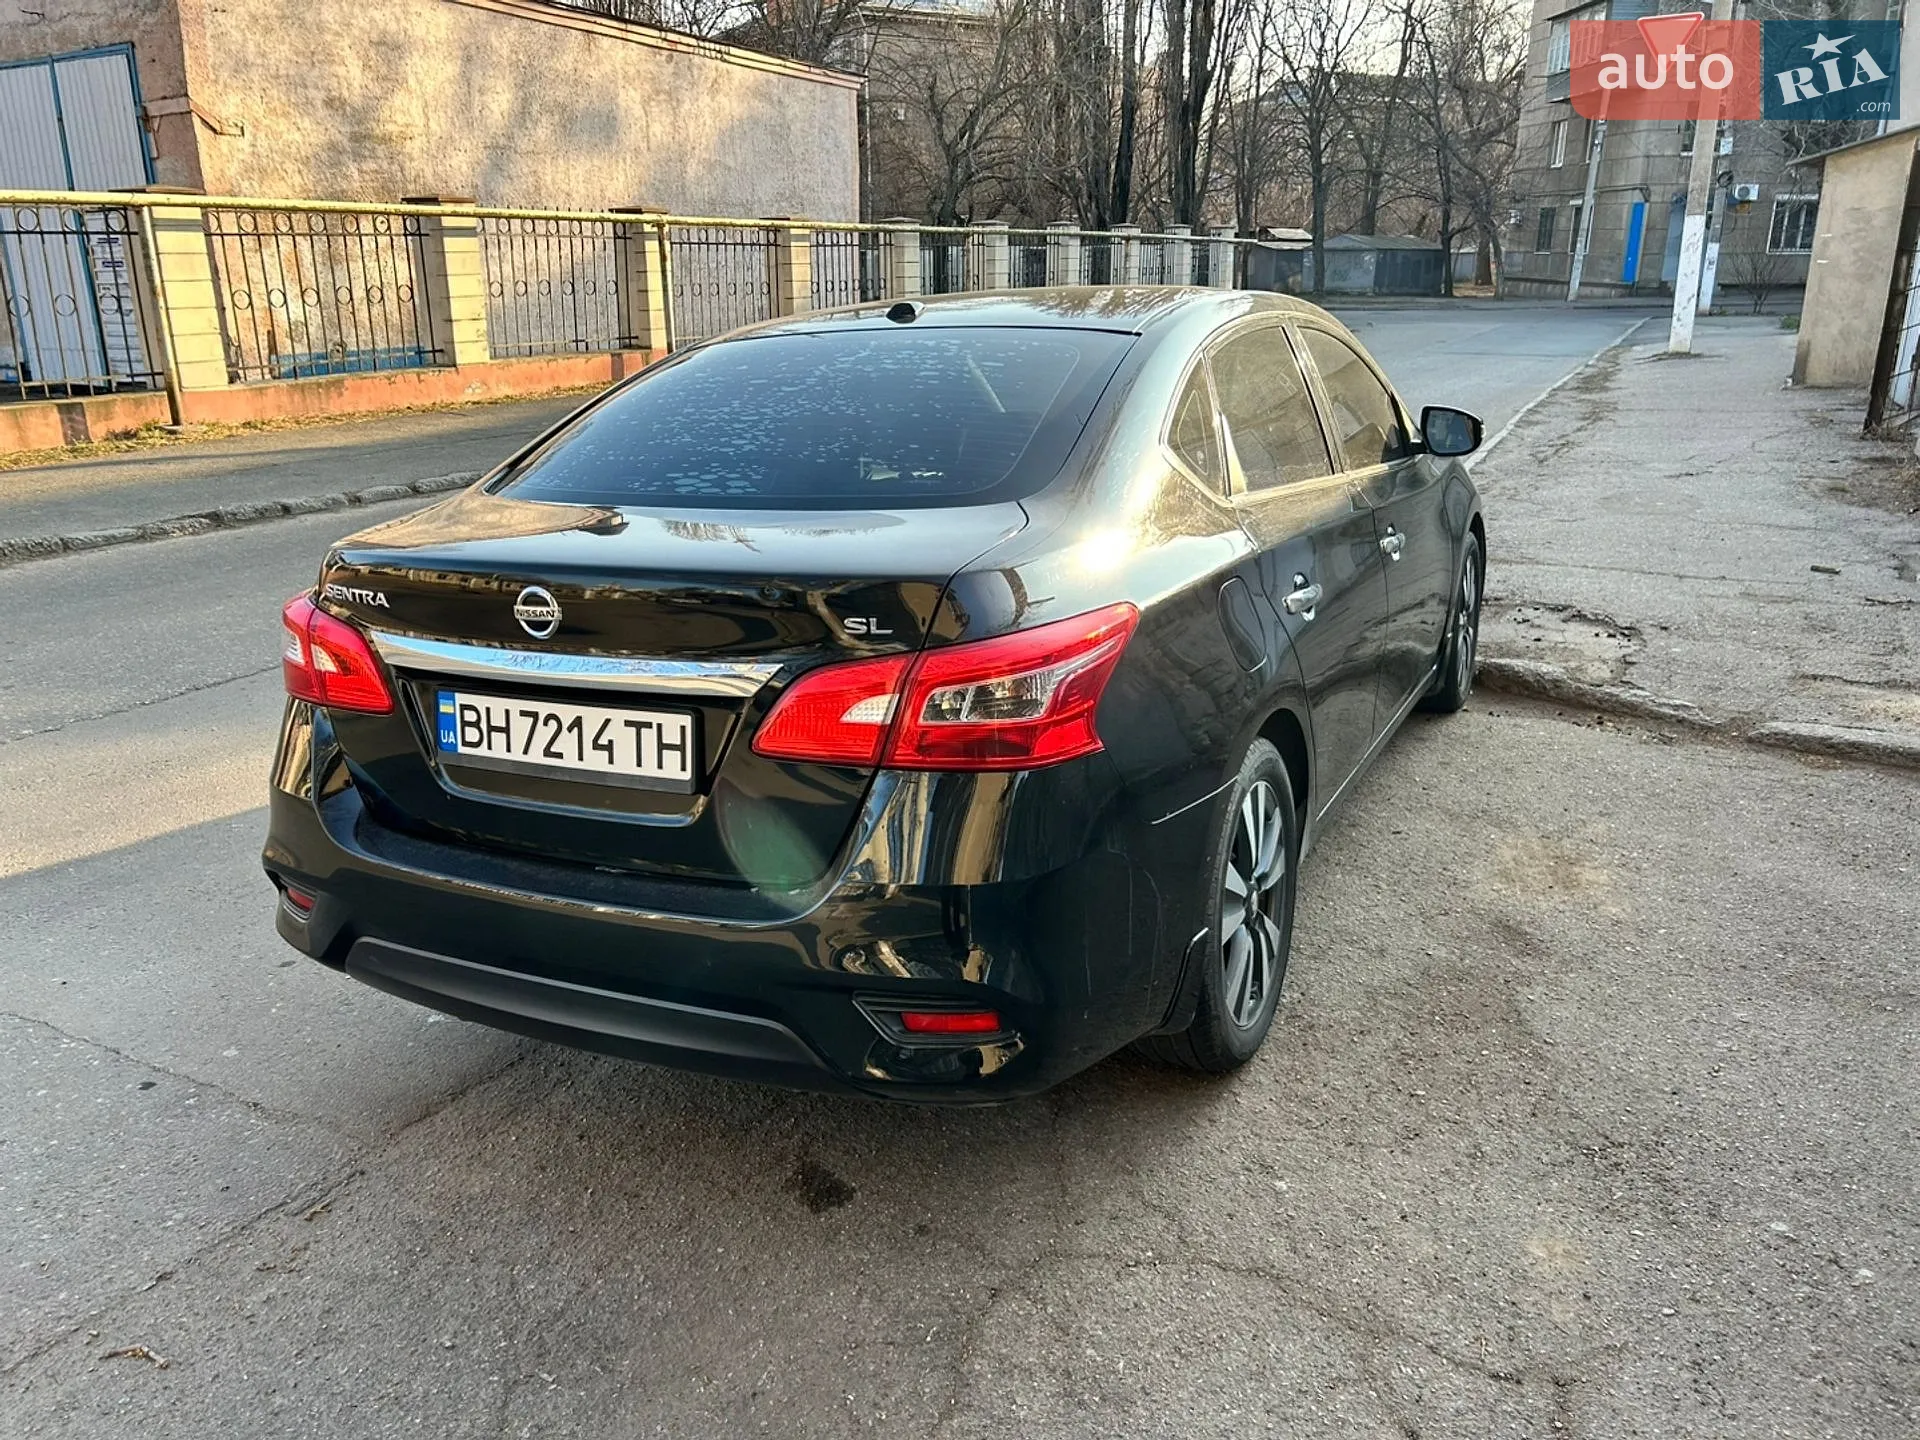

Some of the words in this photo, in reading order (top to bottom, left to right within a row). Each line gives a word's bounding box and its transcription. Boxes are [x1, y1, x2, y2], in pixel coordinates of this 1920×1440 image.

[325, 583, 390, 609] SENTRA
[516, 608, 555, 618] NISSAN
[843, 617, 894, 635] SL
[440, 729, 456, 744] UA
